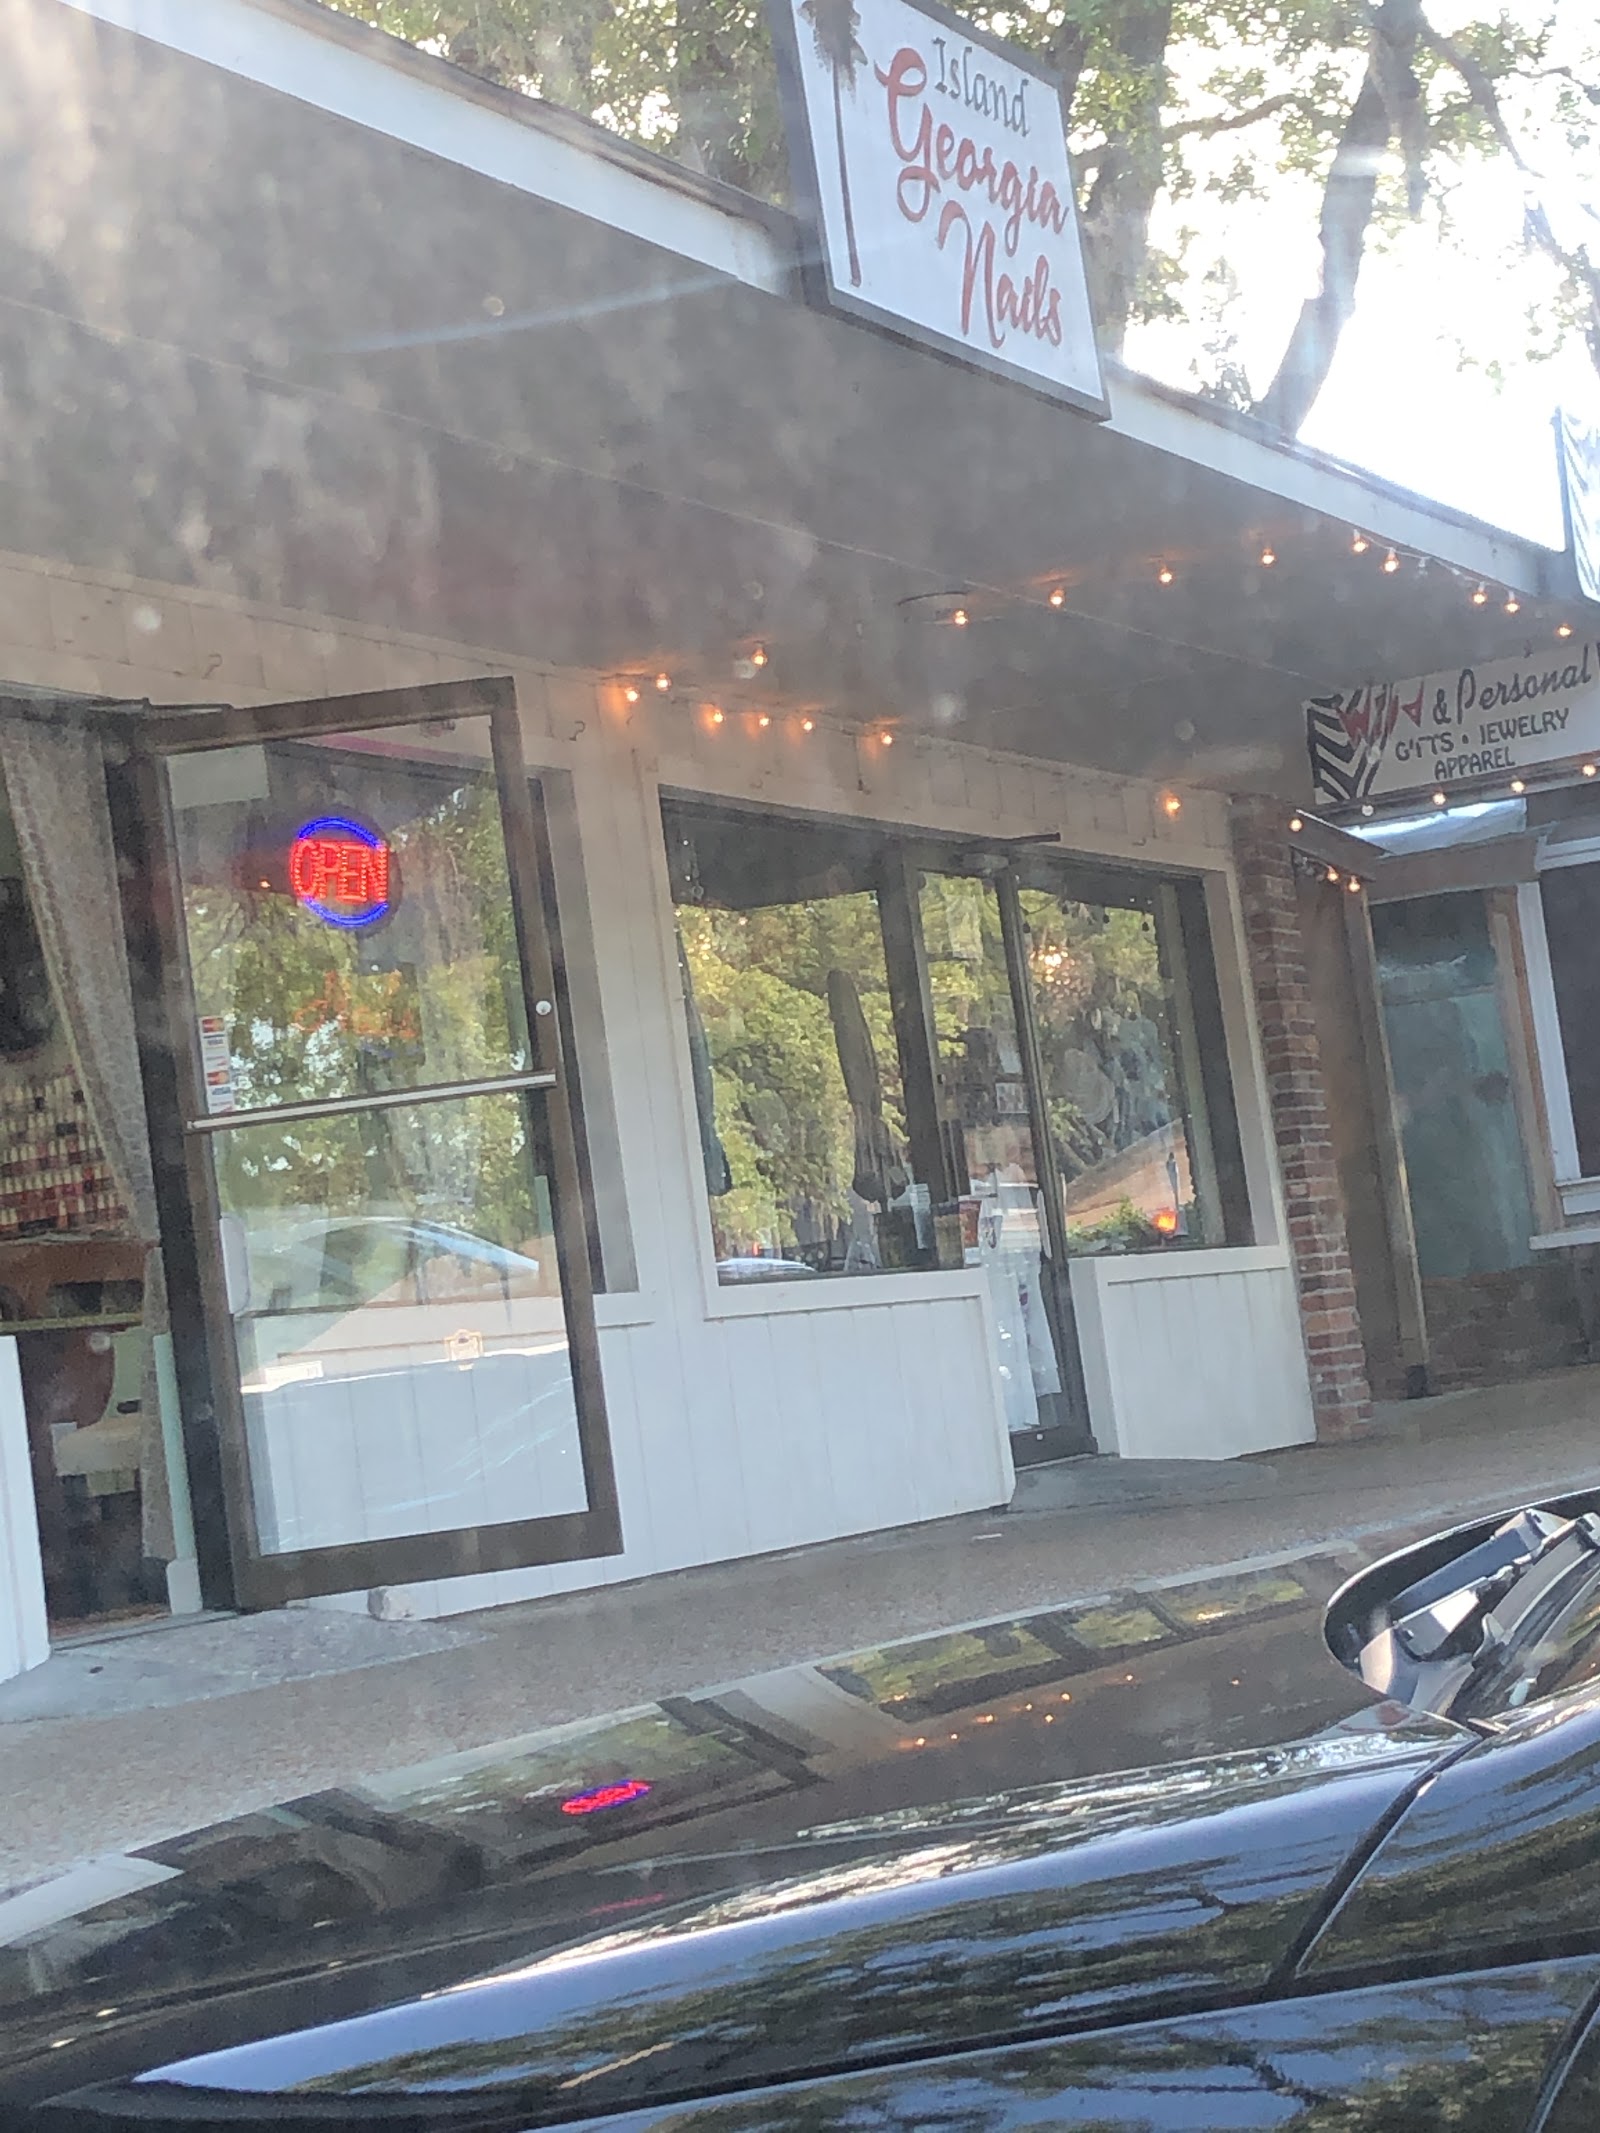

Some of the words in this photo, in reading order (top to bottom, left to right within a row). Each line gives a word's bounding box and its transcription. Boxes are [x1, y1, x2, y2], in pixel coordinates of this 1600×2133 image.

[932, 36, 1031, 137] Island
[873, 47, 1069, 257] Georgia
[937, 200, 1063, 349] Nails
[1432, 688, 1452, 726] &
[1457, 642, 1592, 725] Personal
[1434, 746, 1516, 781] APPAREL
[289, 839, 388, 904] OPEN
